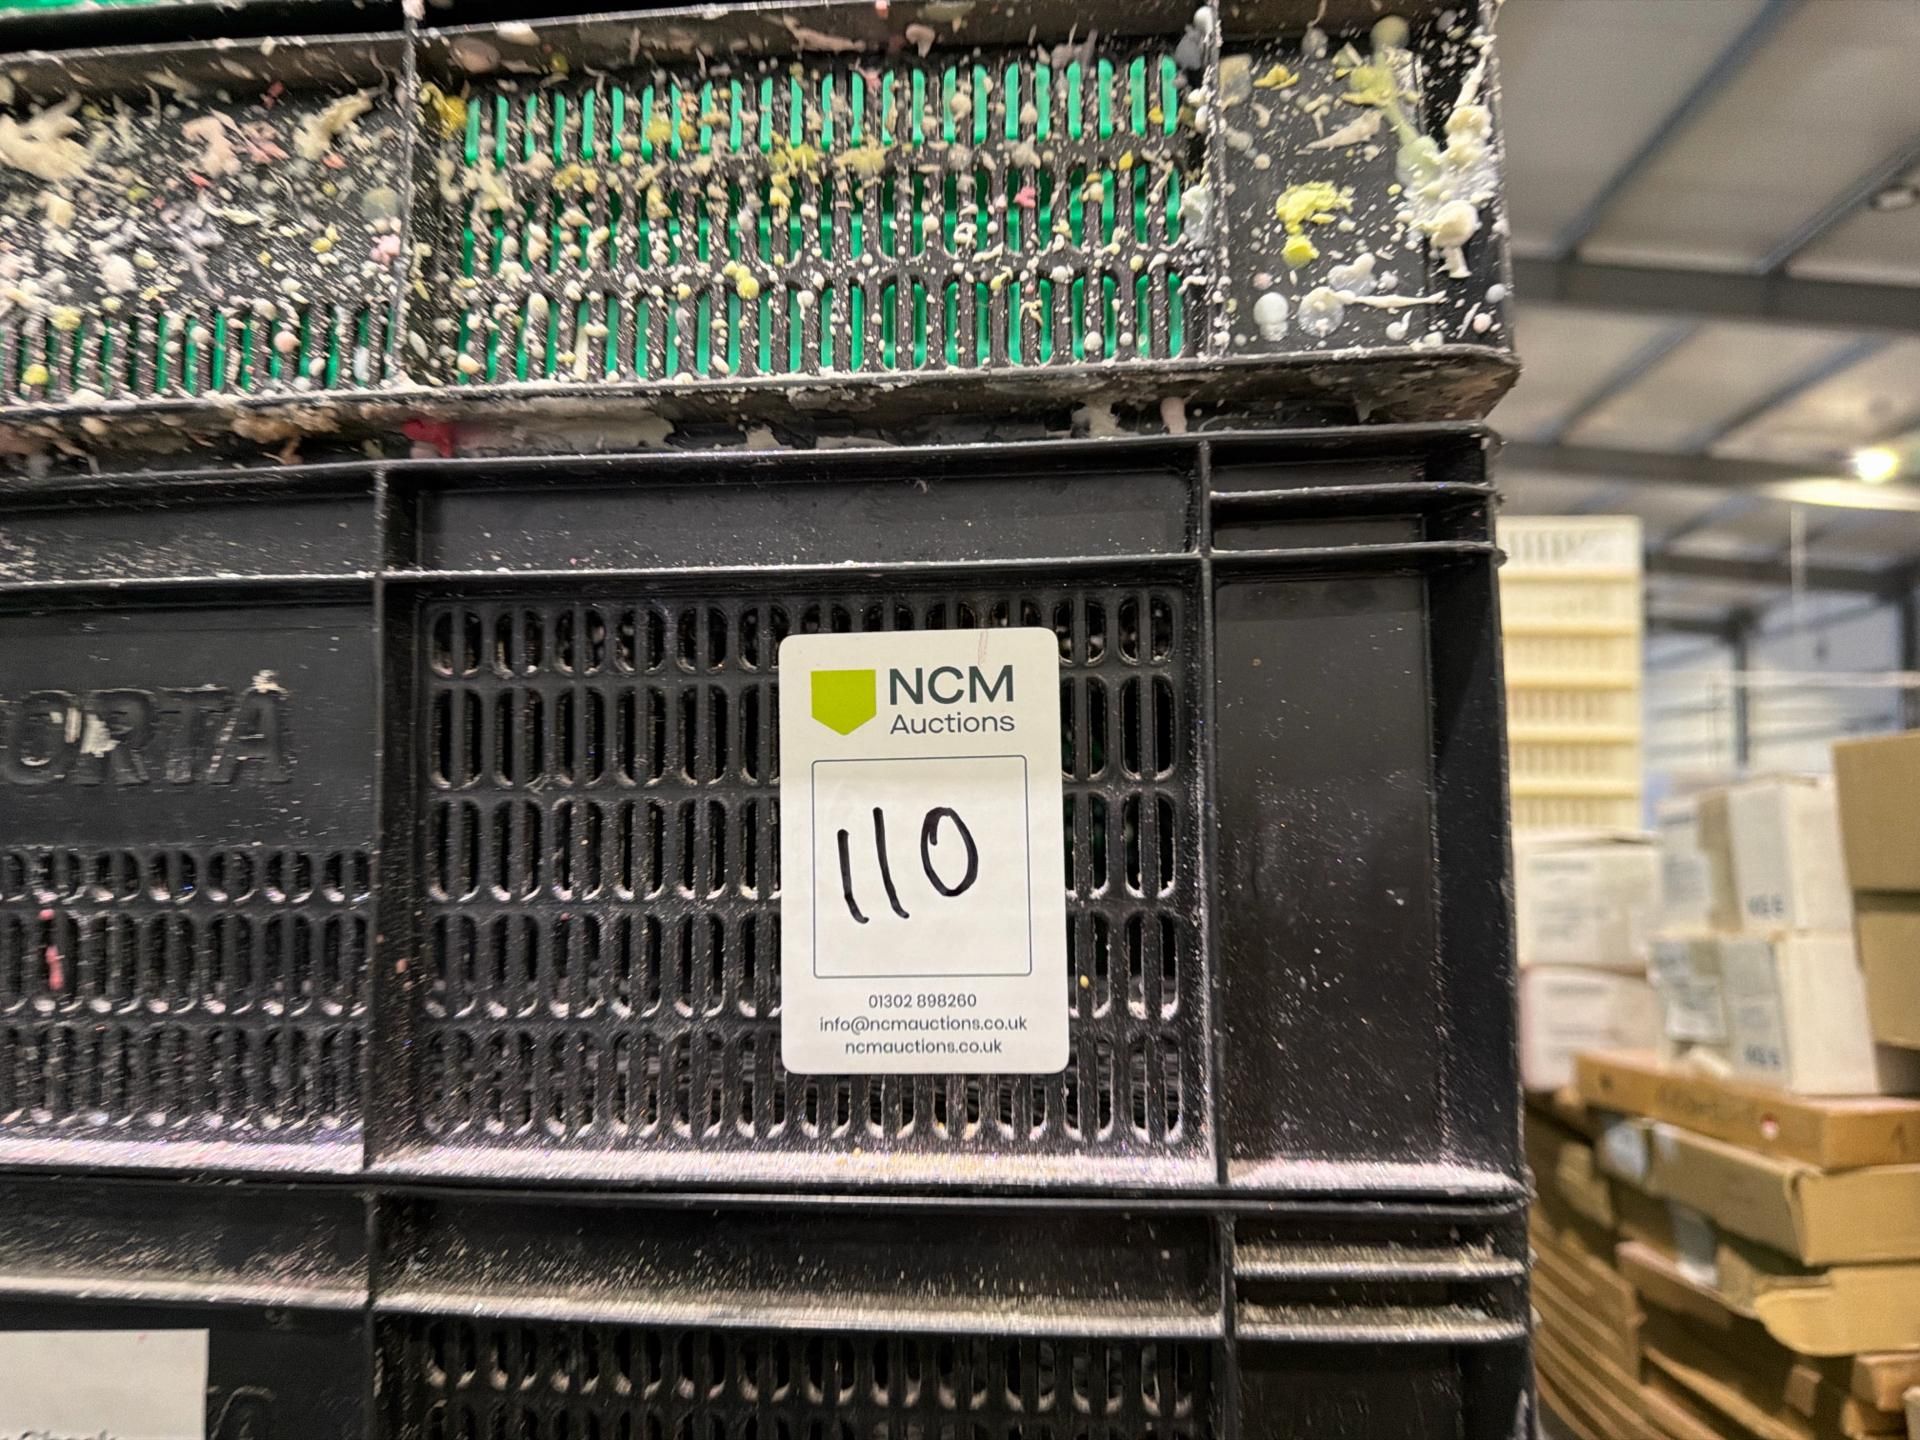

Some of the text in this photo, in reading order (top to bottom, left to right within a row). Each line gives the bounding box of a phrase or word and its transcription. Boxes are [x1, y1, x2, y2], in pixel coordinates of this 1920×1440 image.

[889, 665, 1015, 706] NCM
[889, 712, 1016, 736] Auctions
[836, 806, 979, 924] 110
[868, 993, 977, 1009] 01302 898260
[819, 1015, 1028, 1036] info@ncmauctions.co.uk
[845, 1038, 1003, 1055] ncmauctions.co.uk
